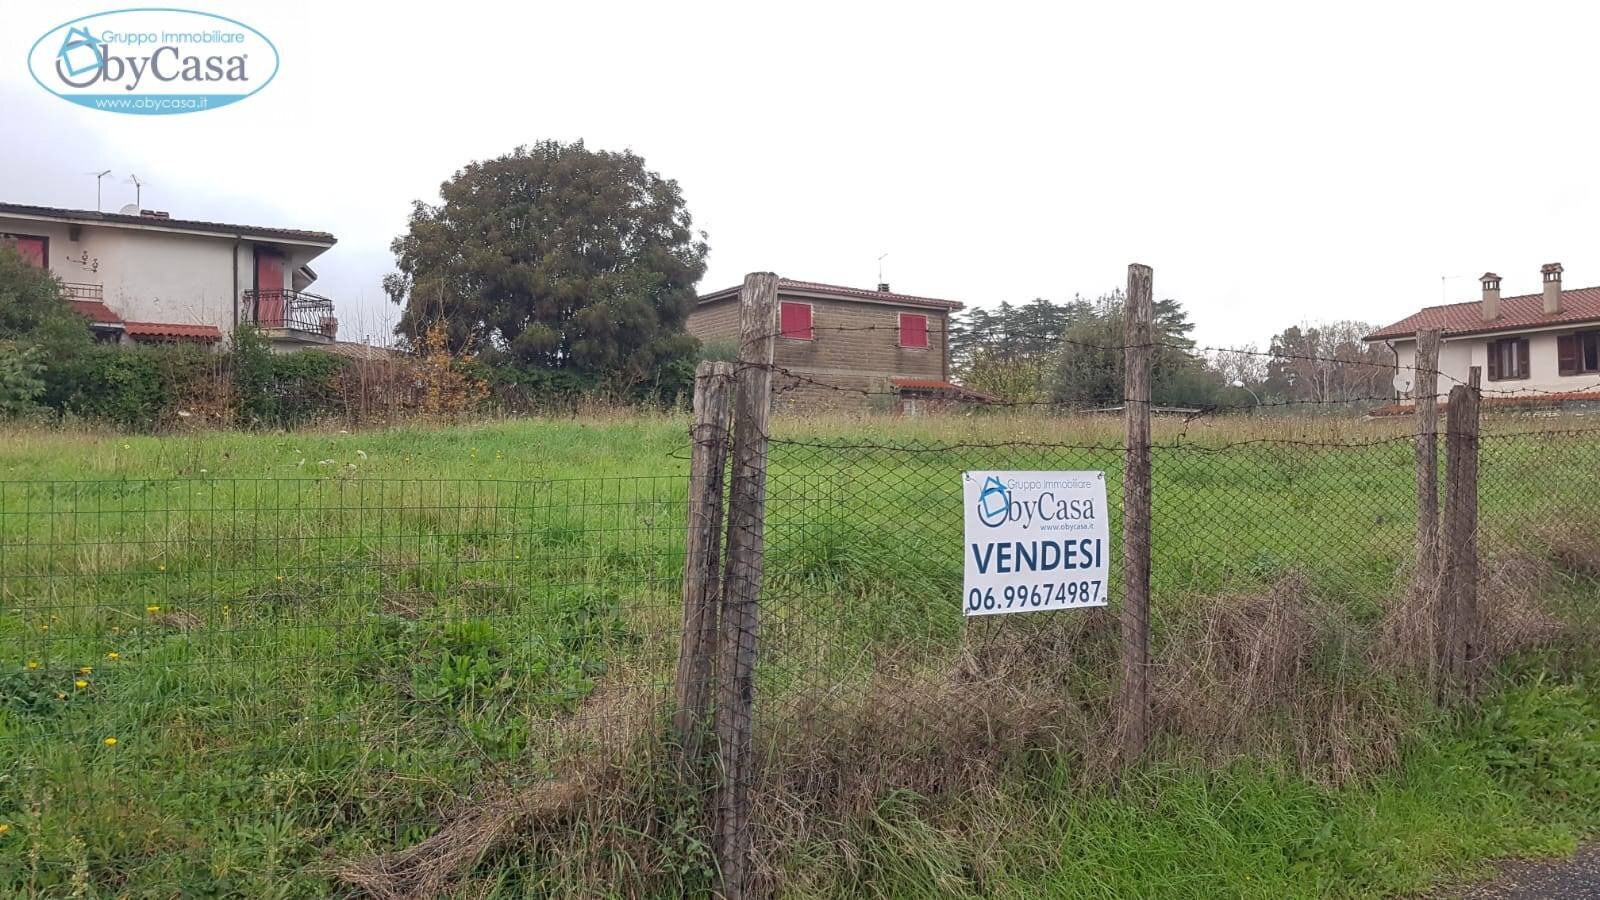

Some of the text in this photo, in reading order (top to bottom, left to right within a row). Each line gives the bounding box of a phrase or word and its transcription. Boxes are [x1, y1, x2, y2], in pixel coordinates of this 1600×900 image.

[1007, 478, 1092, 491] Gruppo Immobiliare
[978, 488, 1095, 529] ObyCasa
[1040, 523, 1094, 532] www.obycasa.it
[972, 539, 1101, 574] VENDESI
[969, 580, 1101, 611] 06.99674987
